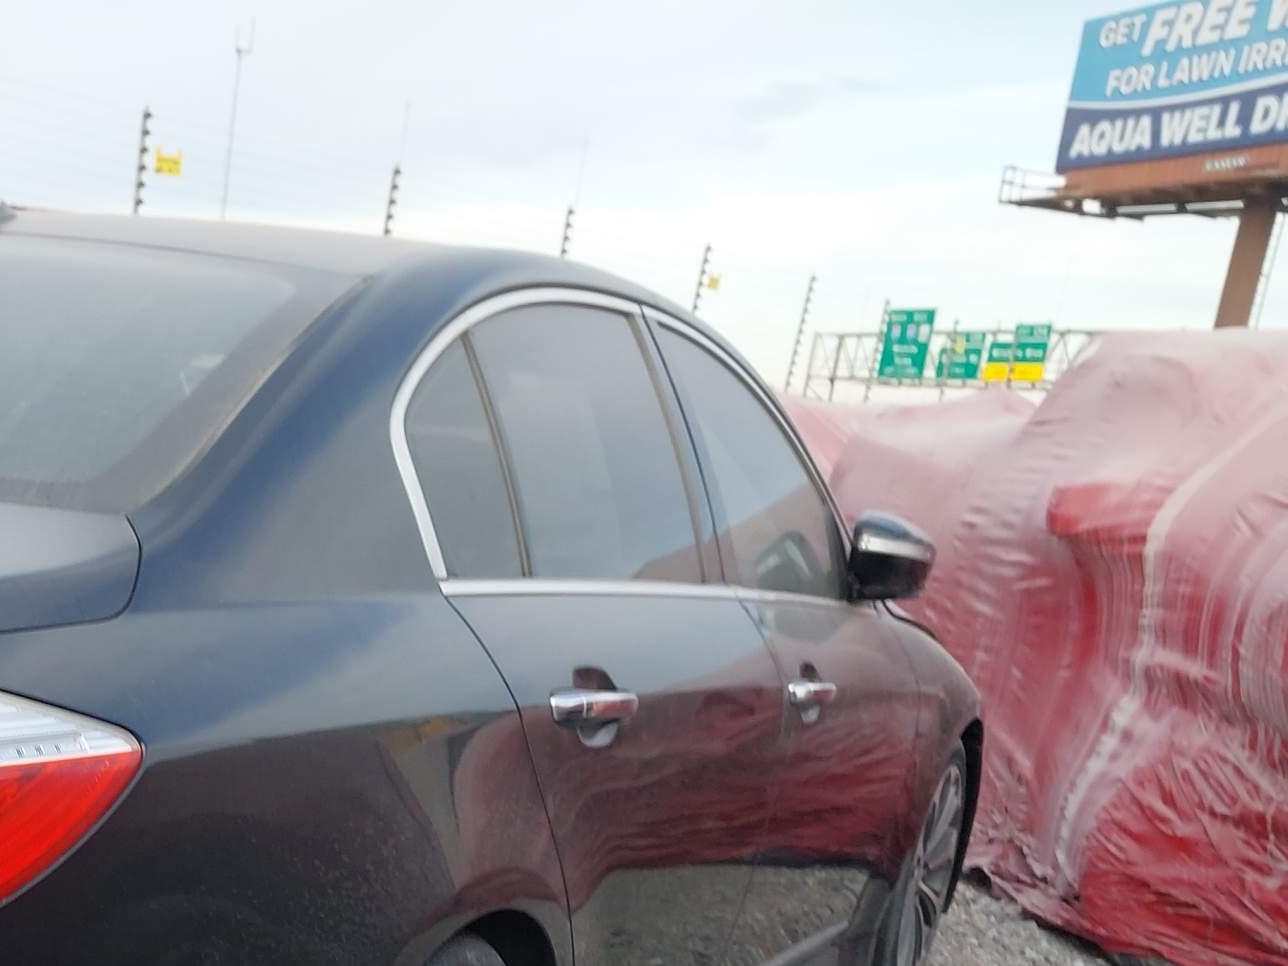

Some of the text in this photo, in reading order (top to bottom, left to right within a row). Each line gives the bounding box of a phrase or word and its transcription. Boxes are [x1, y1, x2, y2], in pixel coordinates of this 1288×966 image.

[1099, 14, 1147, 49] GET
[1140, 0, 1257, 58] FREE
[1105, 63, 1155, 97] FOR
[1157, 48, 1236, 89] LAWN
[1068, 115, 1152, 158] AQUA
[1159, 101, 1243, 147] WELL
